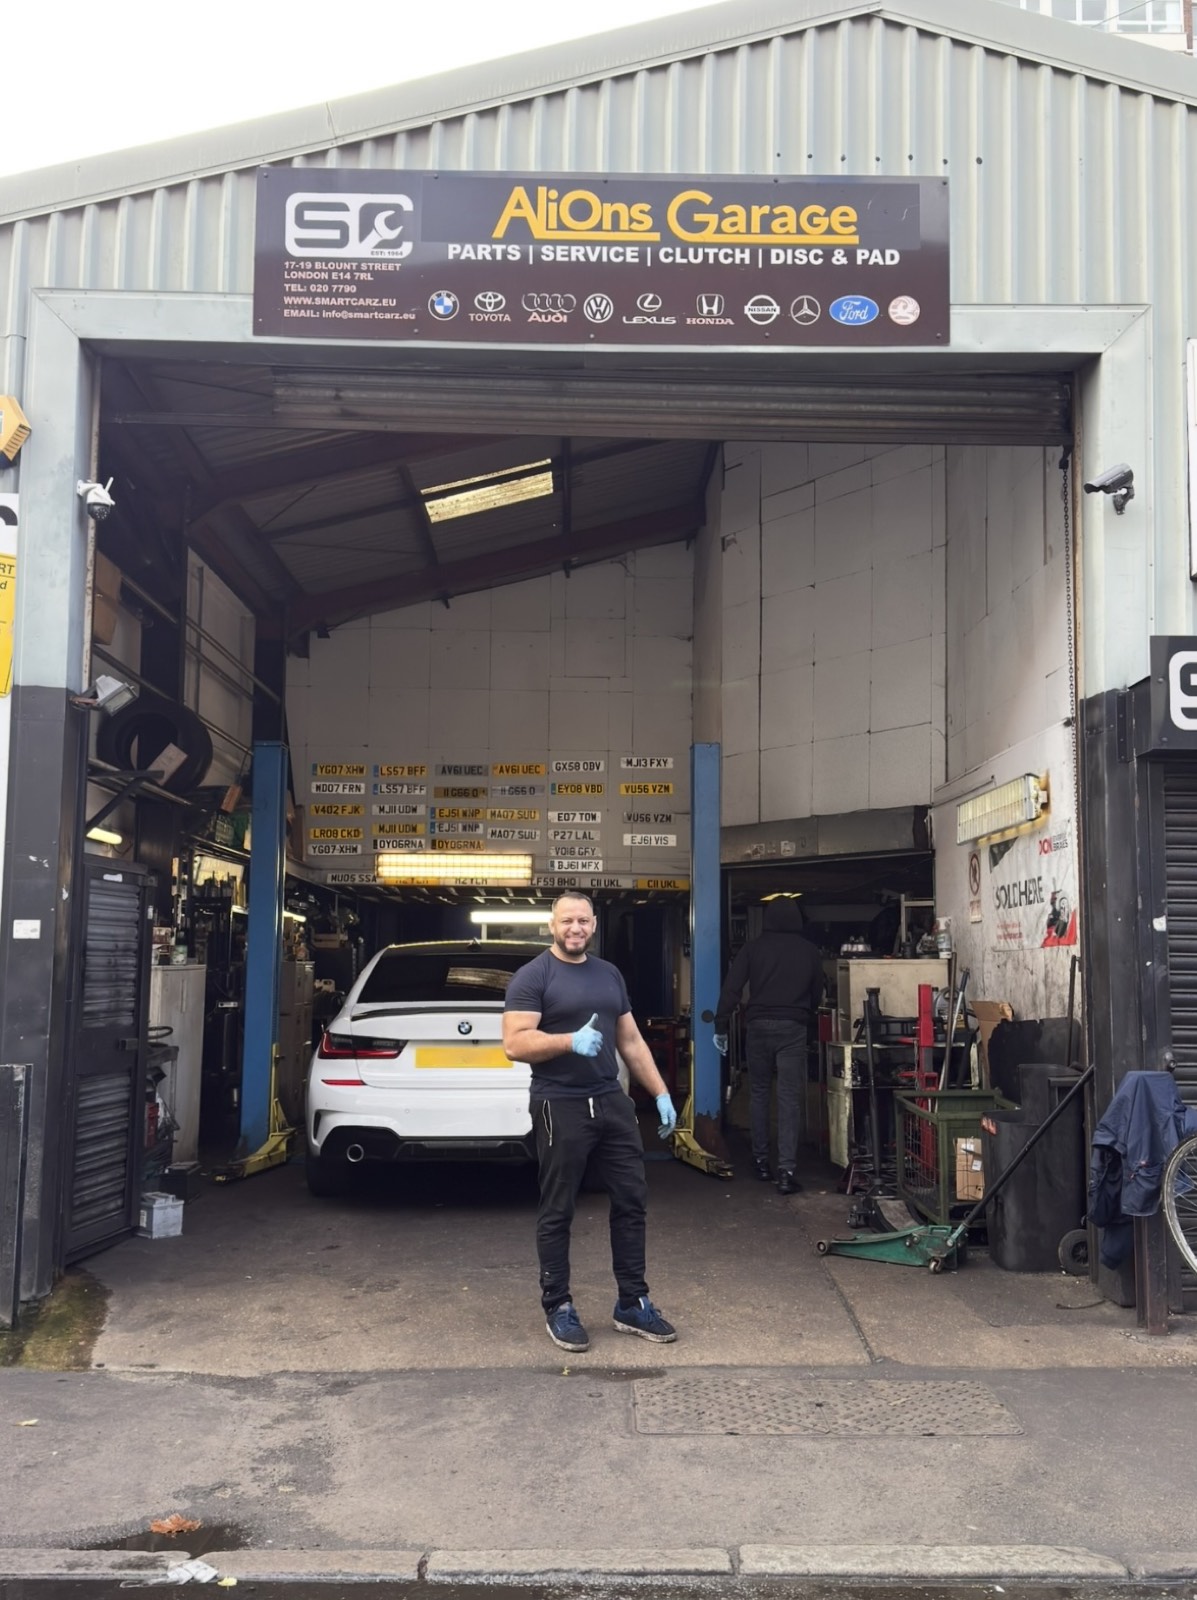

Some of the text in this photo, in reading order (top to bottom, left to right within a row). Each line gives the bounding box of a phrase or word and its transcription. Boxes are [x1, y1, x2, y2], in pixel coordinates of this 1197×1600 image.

[667, 189, 859, 244] Garage
[447, 244, 521, 261] PARTS
[541, 246, 639, 263] SERVICE
[659, 247, 750, 264] CLUTCH
[771, 249, 823, 265] DISC
[831, 249, 848, 265] &
[856, 249, 900, 265] PAD
[284, 261, 401, 271] 17-19 BLOUNT STREET
[284, 271, 374, 280] LONDON E14 7RL
[284, 284, 357, 293] TEL: 020 7790
[283, 296, 397, 307] WWW.SMARTCARZ.EU
[283, 309, 416, 320] EMAIL: info@smartcarz.eu
[839, 300, 868, 320] Ford
[468, 313, 511, 322] TOYOTA
[623, 316, 676, 324] LEXUS
[380, 766, 405, 776] LS57
[342, 784, 361, 793] FRN
